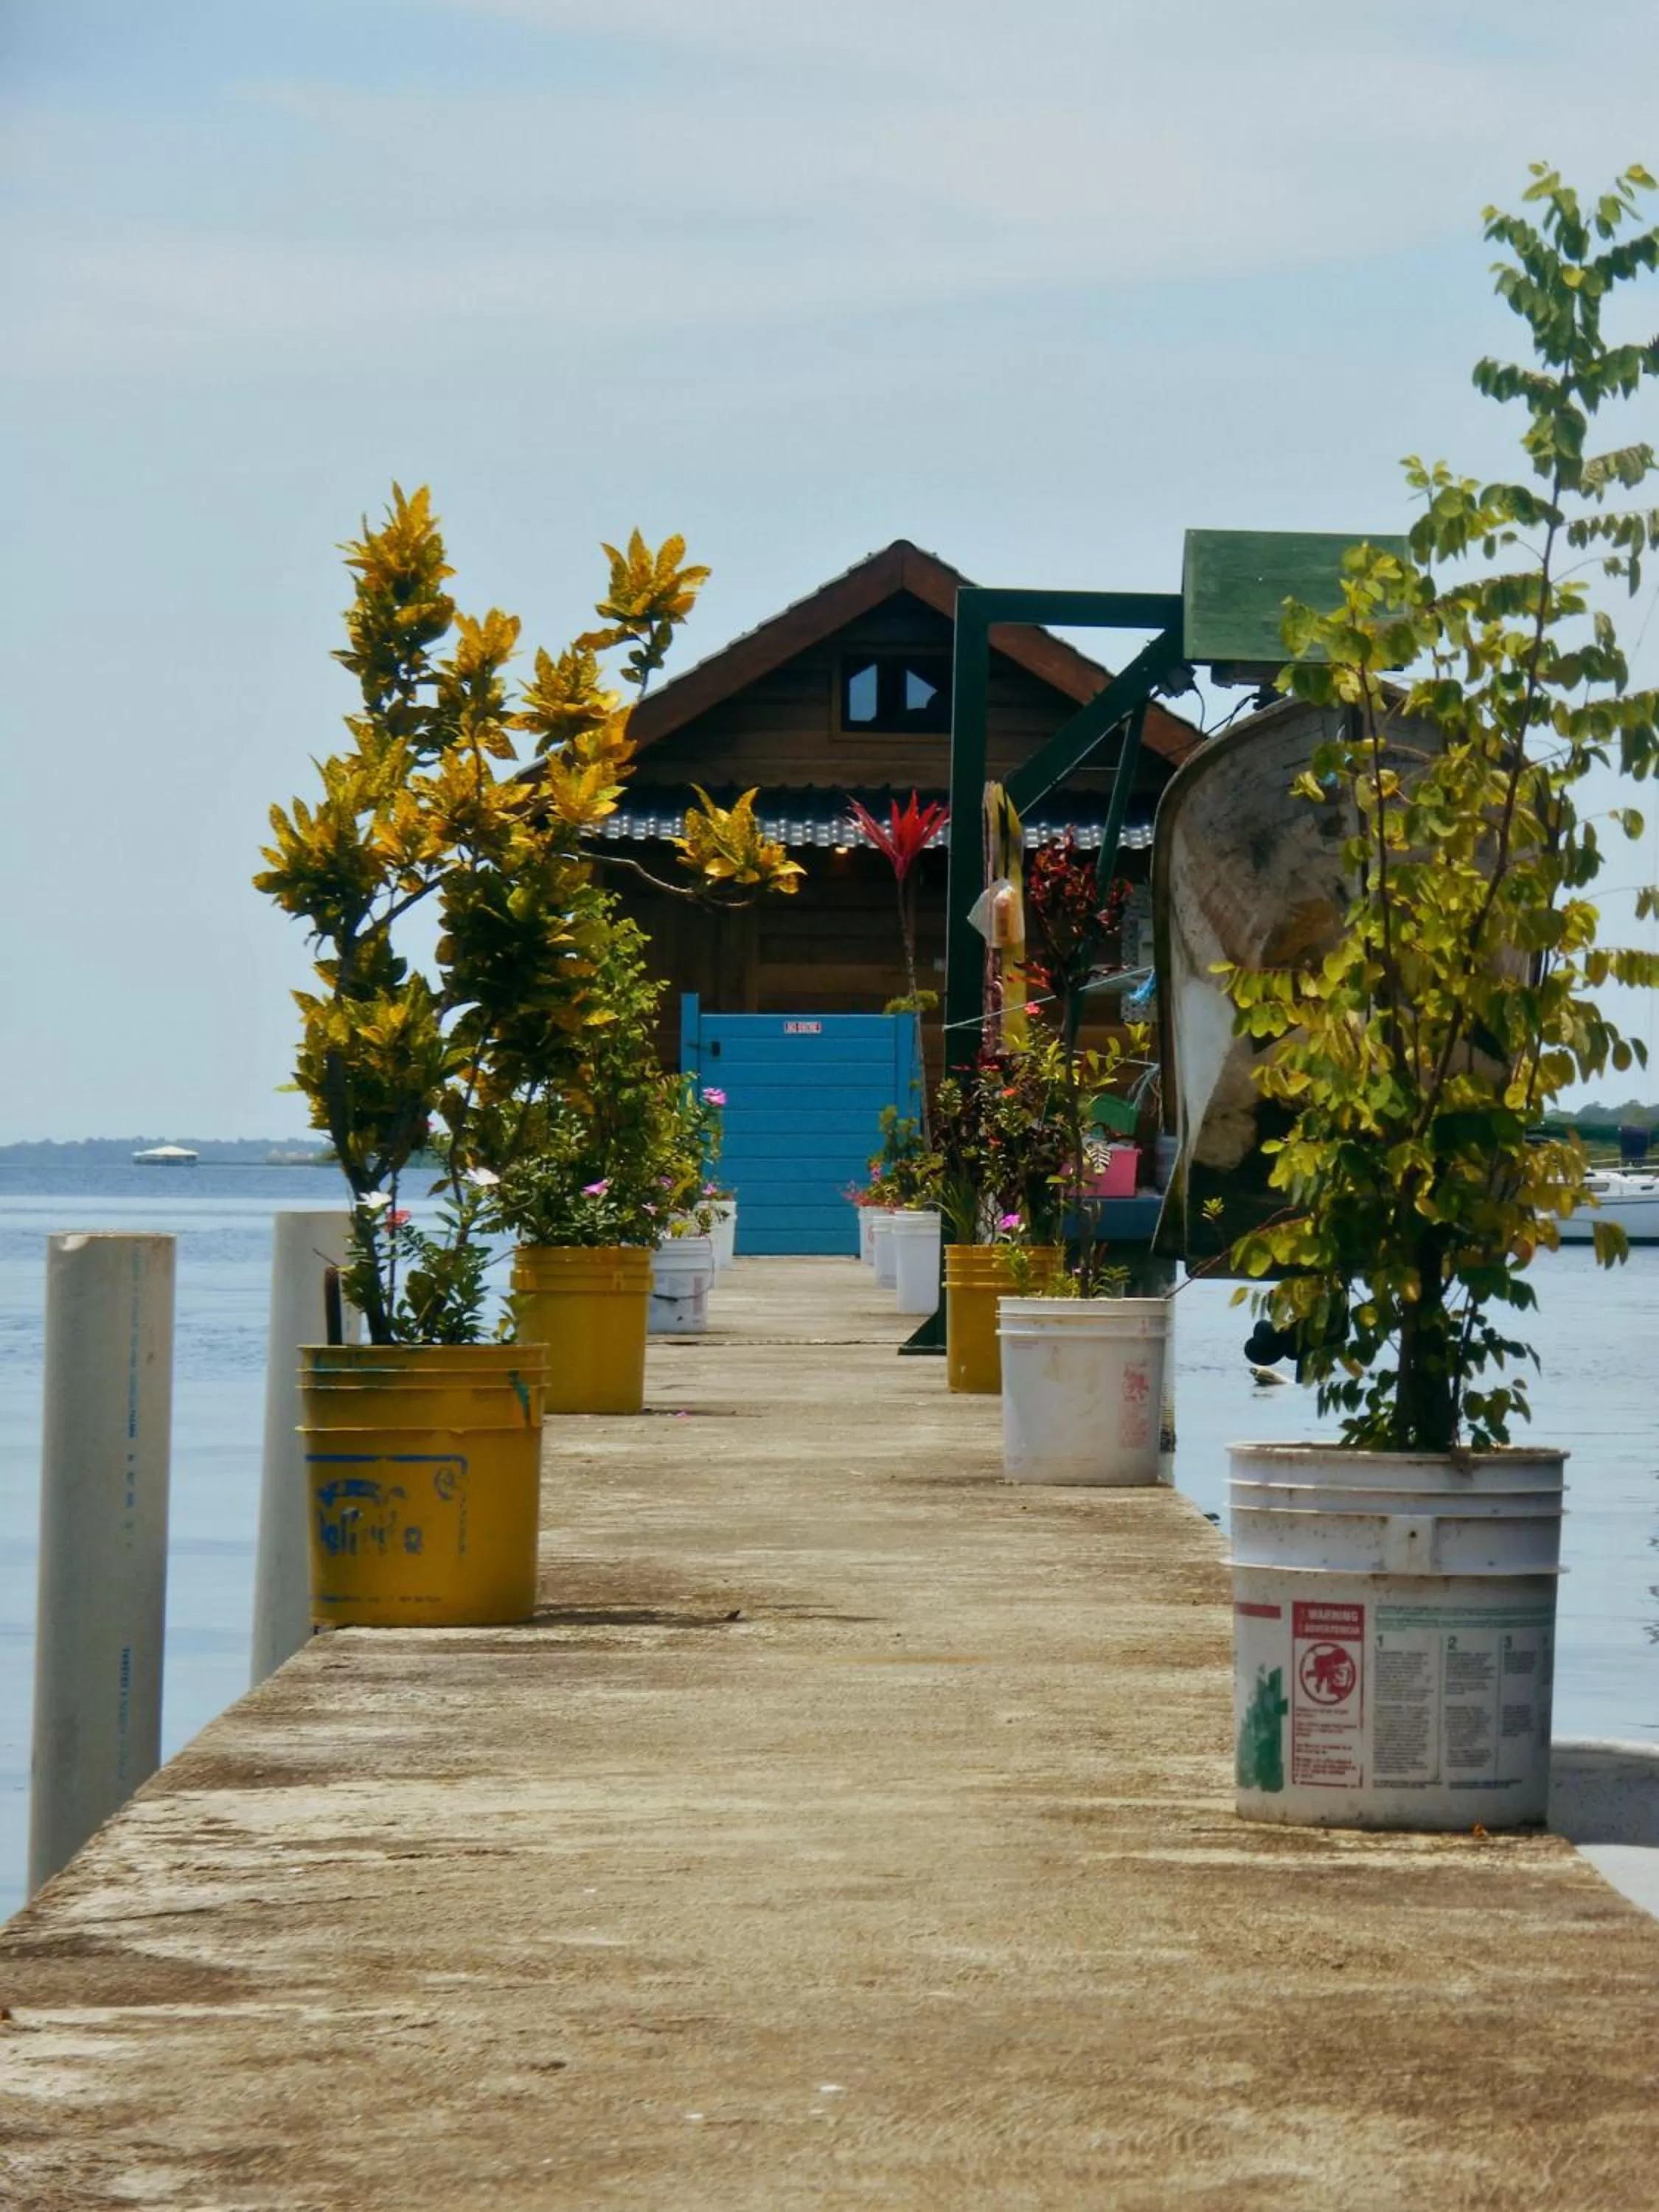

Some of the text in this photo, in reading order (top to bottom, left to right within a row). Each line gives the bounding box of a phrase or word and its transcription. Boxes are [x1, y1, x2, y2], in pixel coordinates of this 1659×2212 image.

[1308, 1609, 1358, 1622] WARNING
[1376, 1635, 1384, 1648] 1
[1447, 1635, 1458, 1650] 2
